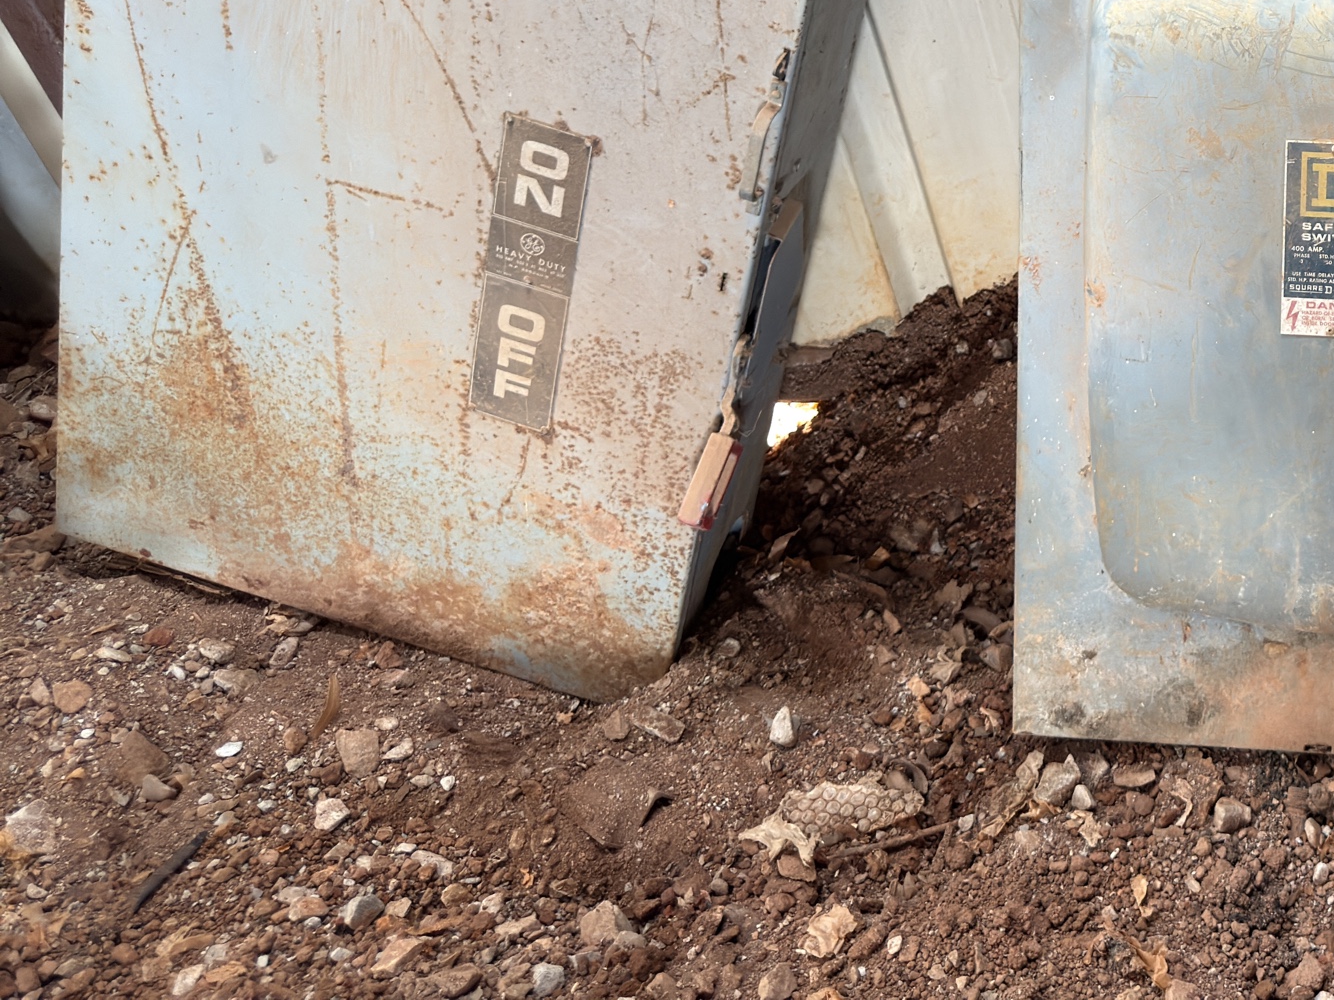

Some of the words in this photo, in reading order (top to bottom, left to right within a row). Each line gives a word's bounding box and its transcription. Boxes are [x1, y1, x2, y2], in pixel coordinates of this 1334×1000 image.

[513, 140, 570, 218] ON
[495, 245, 532, 262] HEAVY
[538, 257, 566, 273] DUTY
[1289, 284, 1323, 292] SQUARE
[1324, 285, 1333, 295] D
[492, 304, 546, 399] OFF
